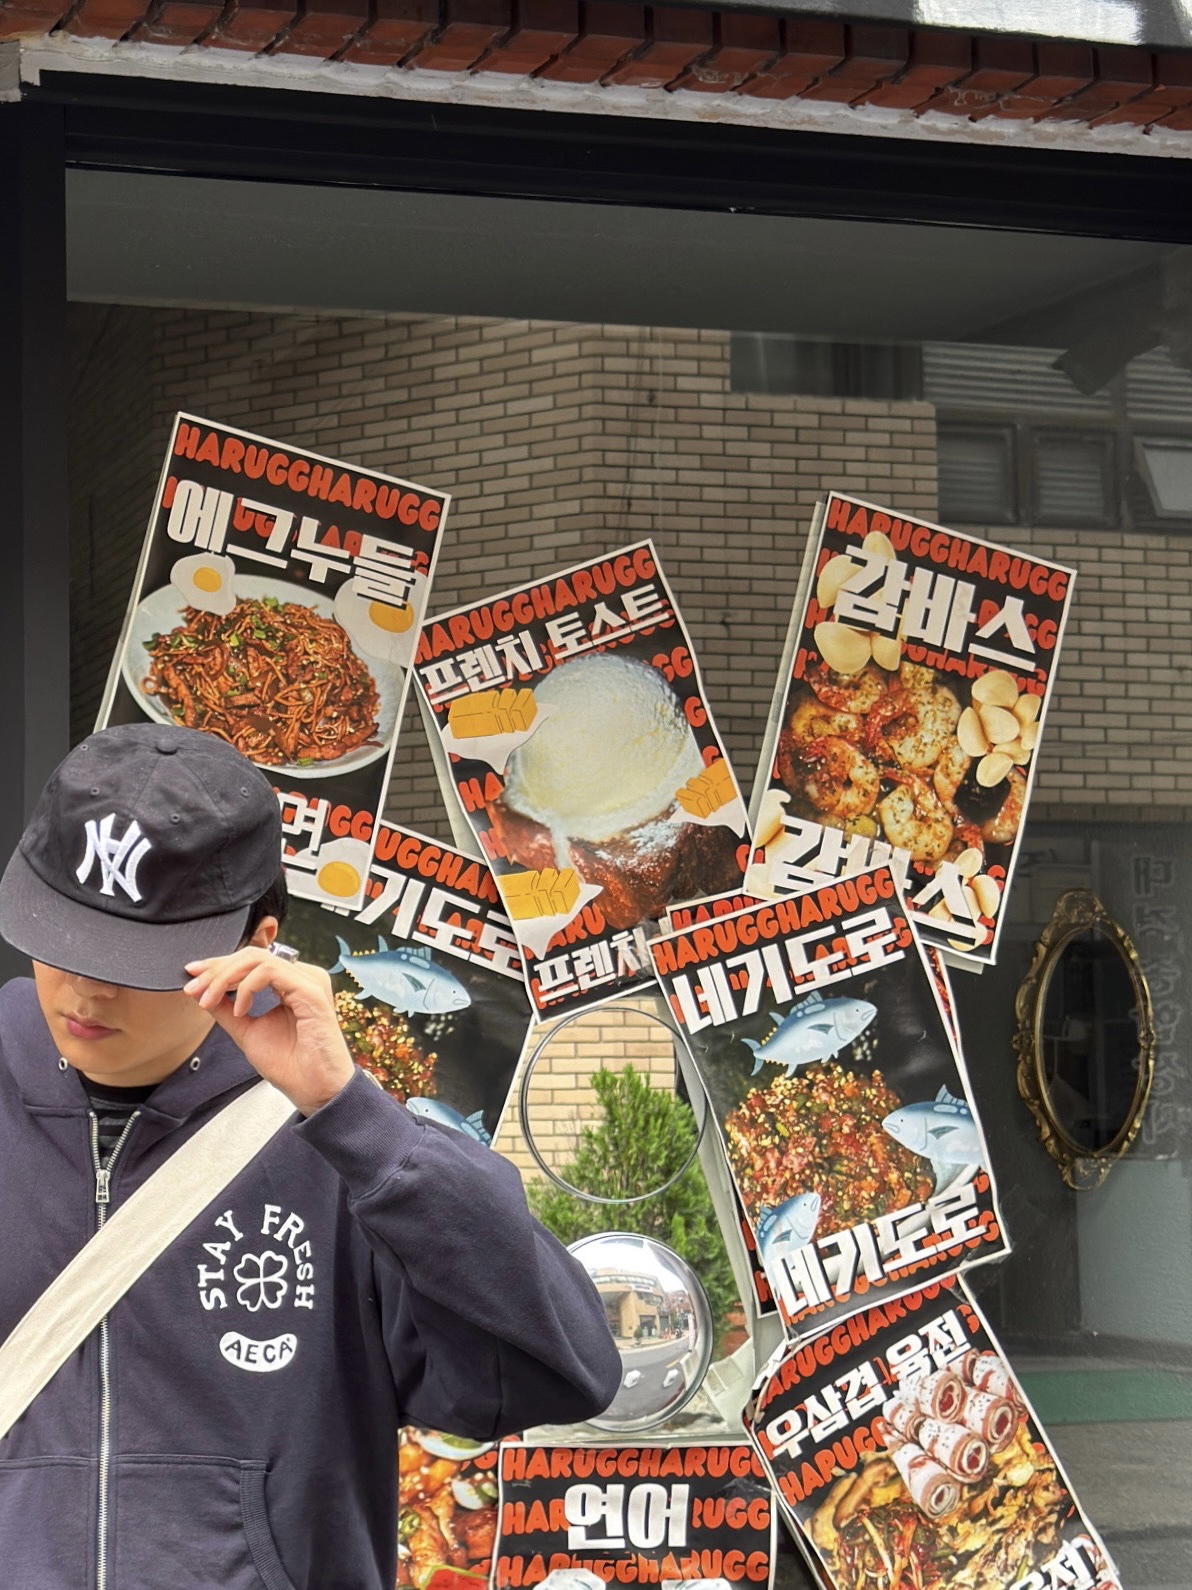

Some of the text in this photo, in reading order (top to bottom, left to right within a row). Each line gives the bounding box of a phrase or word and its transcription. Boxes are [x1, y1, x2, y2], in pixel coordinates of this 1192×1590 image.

[173, 423, 442, 532] HARUGGHARUGG
[166, 479, 417, 609] 에그누들
[419, 630, 543, 705] 프렌치
[545, 584, 670, 660] 토스트
[833, 545, 1037, 672] 감바스
[76, 812, 152, 903] NY
[320, 863, 525, 983] 기도로
[652, 868, 895, 976] HARUGGHARUGG
[671, 907, 906, 1035] 네기도로
[197, 1203, 315, 1311] STAY FRESH
[772, 1183, 987, 1317] 네기도로
[225, 1338, 294, 1364] AECA
[765, 1360, 888, 1459] 우삼겹
[564, 1483, 690, 1550] 연어
